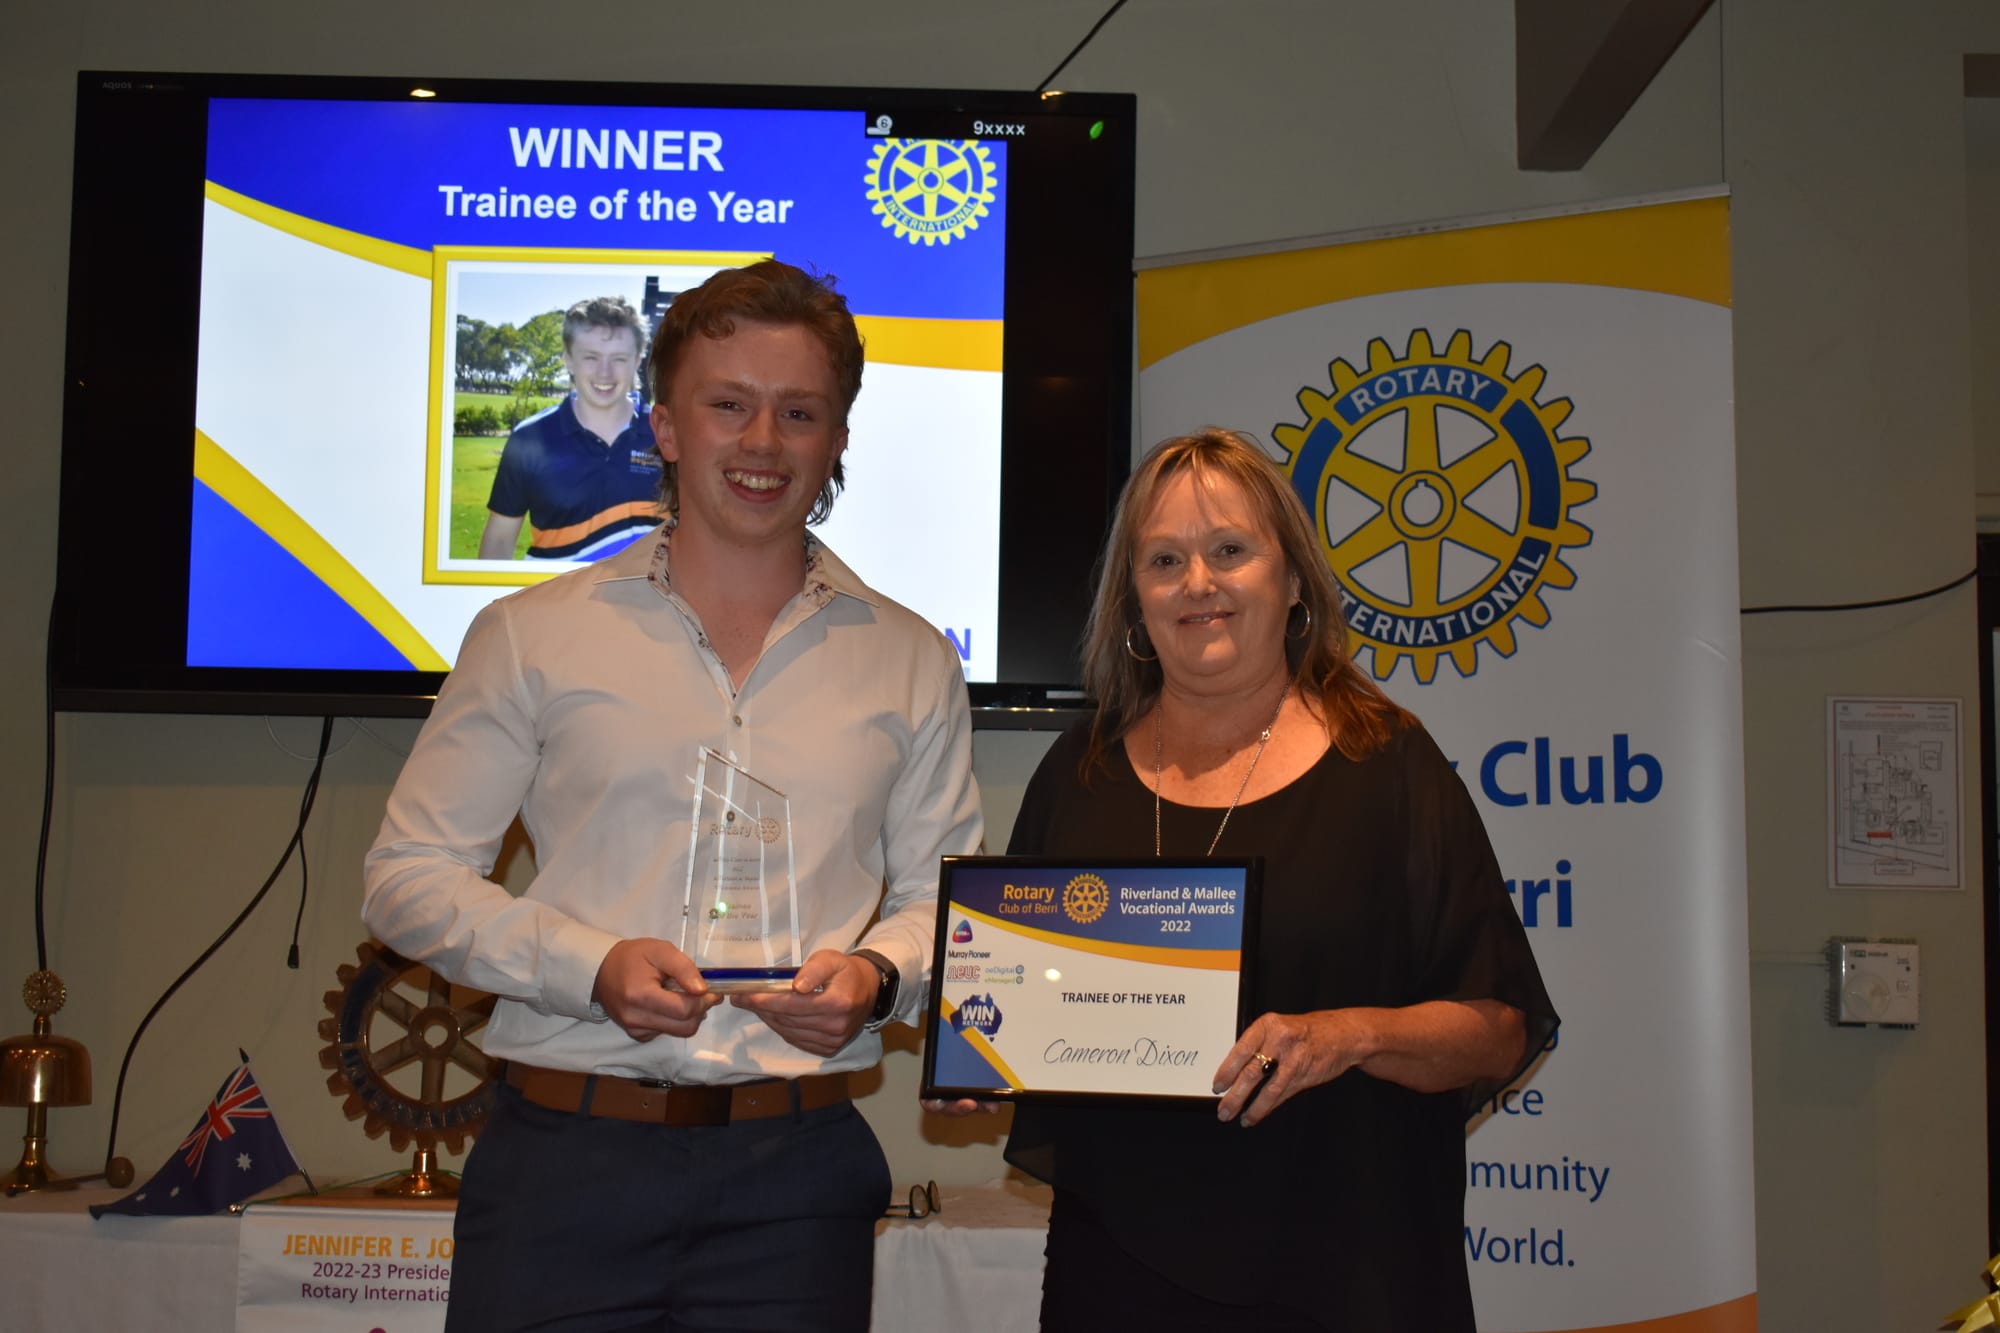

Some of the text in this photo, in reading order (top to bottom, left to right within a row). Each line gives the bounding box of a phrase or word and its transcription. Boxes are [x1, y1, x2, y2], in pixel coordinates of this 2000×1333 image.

[973, 121, 1025, 135] 9xxxx
[509, 127, 724, 172] WINNER
[438, 185, 794, 223] Trainee of the Year
[886, 199, 978, 232] INTERNATIONAL
[1351, 368, 1491, 413] ROTARY
[1336, 553, 1545, 646] TERNATIONAL
[1480, 733, 1663, 807] Club
[1003, 884, 1055, 903] Rotary
[1120, 886, 1236, 900] Riverland & Mallee
[998, 903, 1020, 914] Club
[1022, 903, 1032, 914] of
[1034, 903, 1058, 914] Berri
[1120, 902, 1235, 914] Vocational Awards
[1160, 920, 1191, 932] 2022
[1061, 992, 1186, 1004] TRAINEE OF THE YEAR
[961, 1005, 995, 1021] WIN
[1043, 1037, 1199, 1066] Cameron Dixon
[282, 1234, 393, 1257] JENNIFER
[401, 1237, 419, 1258] E.
[313, 1262, 450, 1280] 2022-23 Preside
[302, 1283, 358, 1303] Rotary
